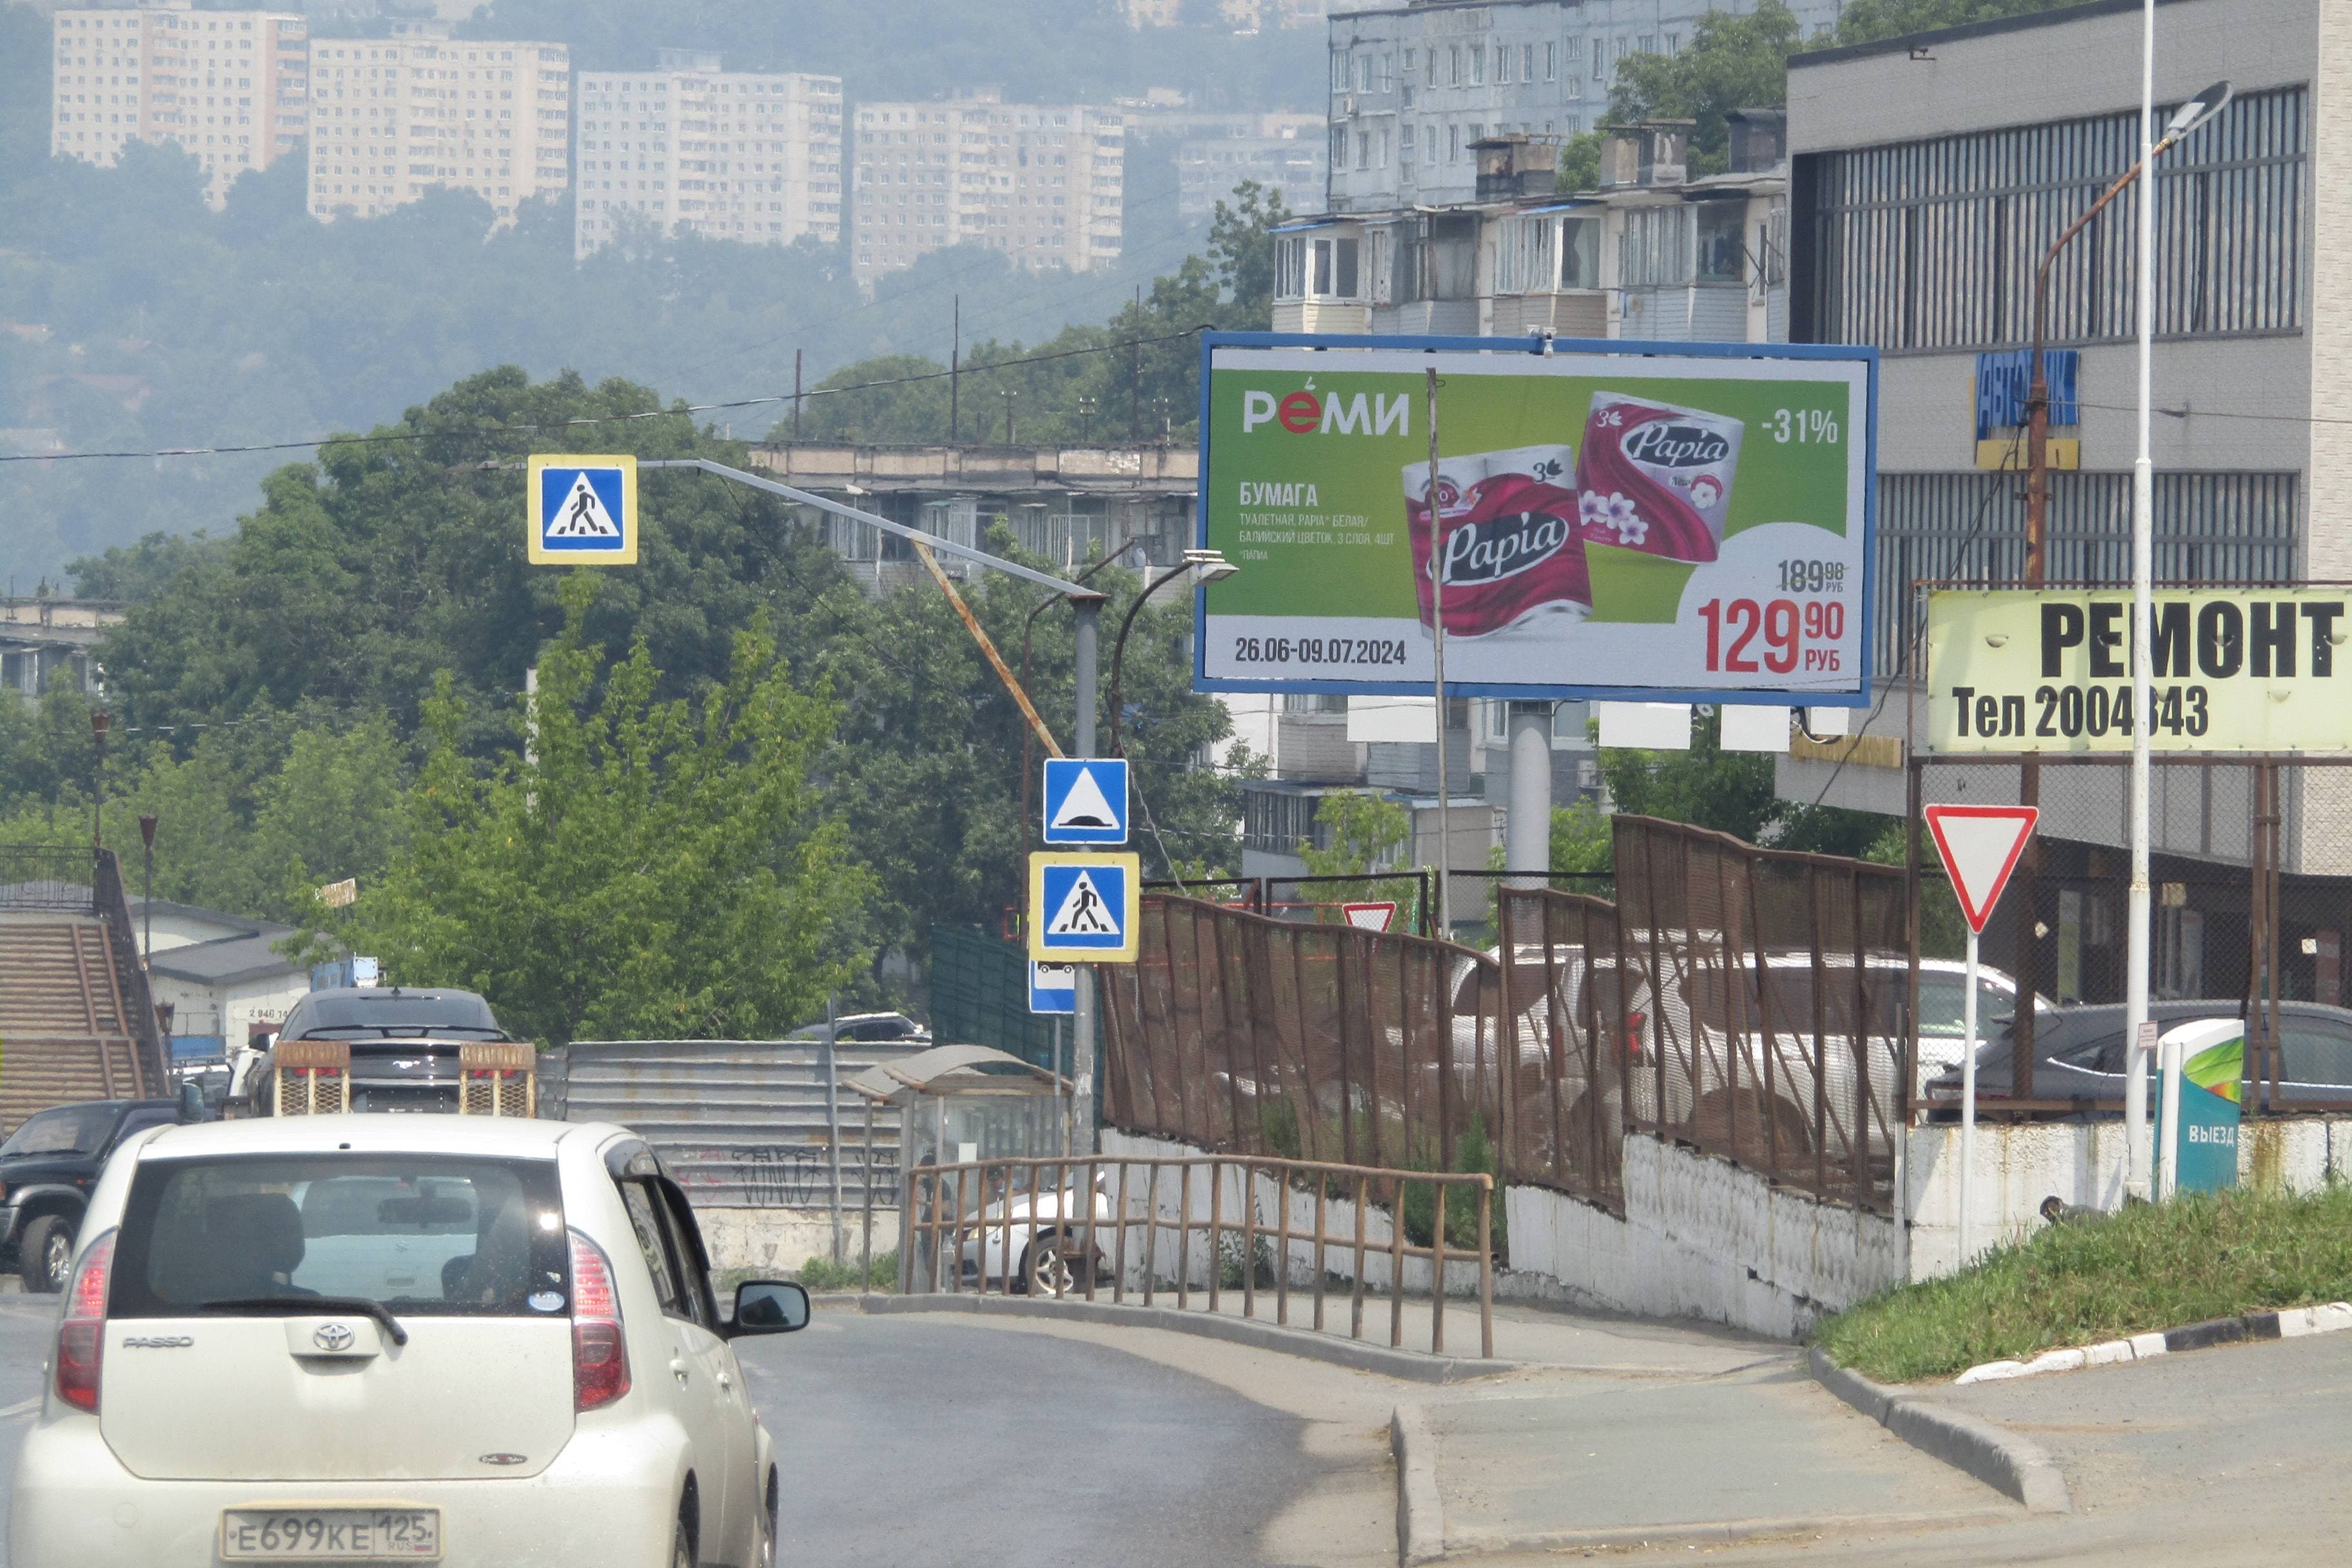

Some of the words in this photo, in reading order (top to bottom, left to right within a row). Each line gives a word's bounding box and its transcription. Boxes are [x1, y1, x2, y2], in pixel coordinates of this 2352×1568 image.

[1762, 408, 1838, 444] -31%
[1632, 424, 1725, 467] Papia
[1533, 462, 1546, 483] 3
[1240, 482, 1318, 506] БУМАГА
[1442, 511, 1560, 582] Papia
[1778, 560, 1823, 592] 189
[1826, 582, 1843, 592] РУБ
[1698, 598, 1800, 673] 129
[1805, 601, 1844, 640] 90
[2041, 600, 2344, 679] РЕМОНТ
[1235, 638, 1406, 665] 26.06-09.07.2024
[1805, 649, 1840, 671] РУБ
[1952, 687, 2024, 737] Тел
[2189, 1125, 2235, 1147] ВЫЕЗД
[123, 1337, 194, 1349] PASSO
[378, 1515, 426, 1541] 125
